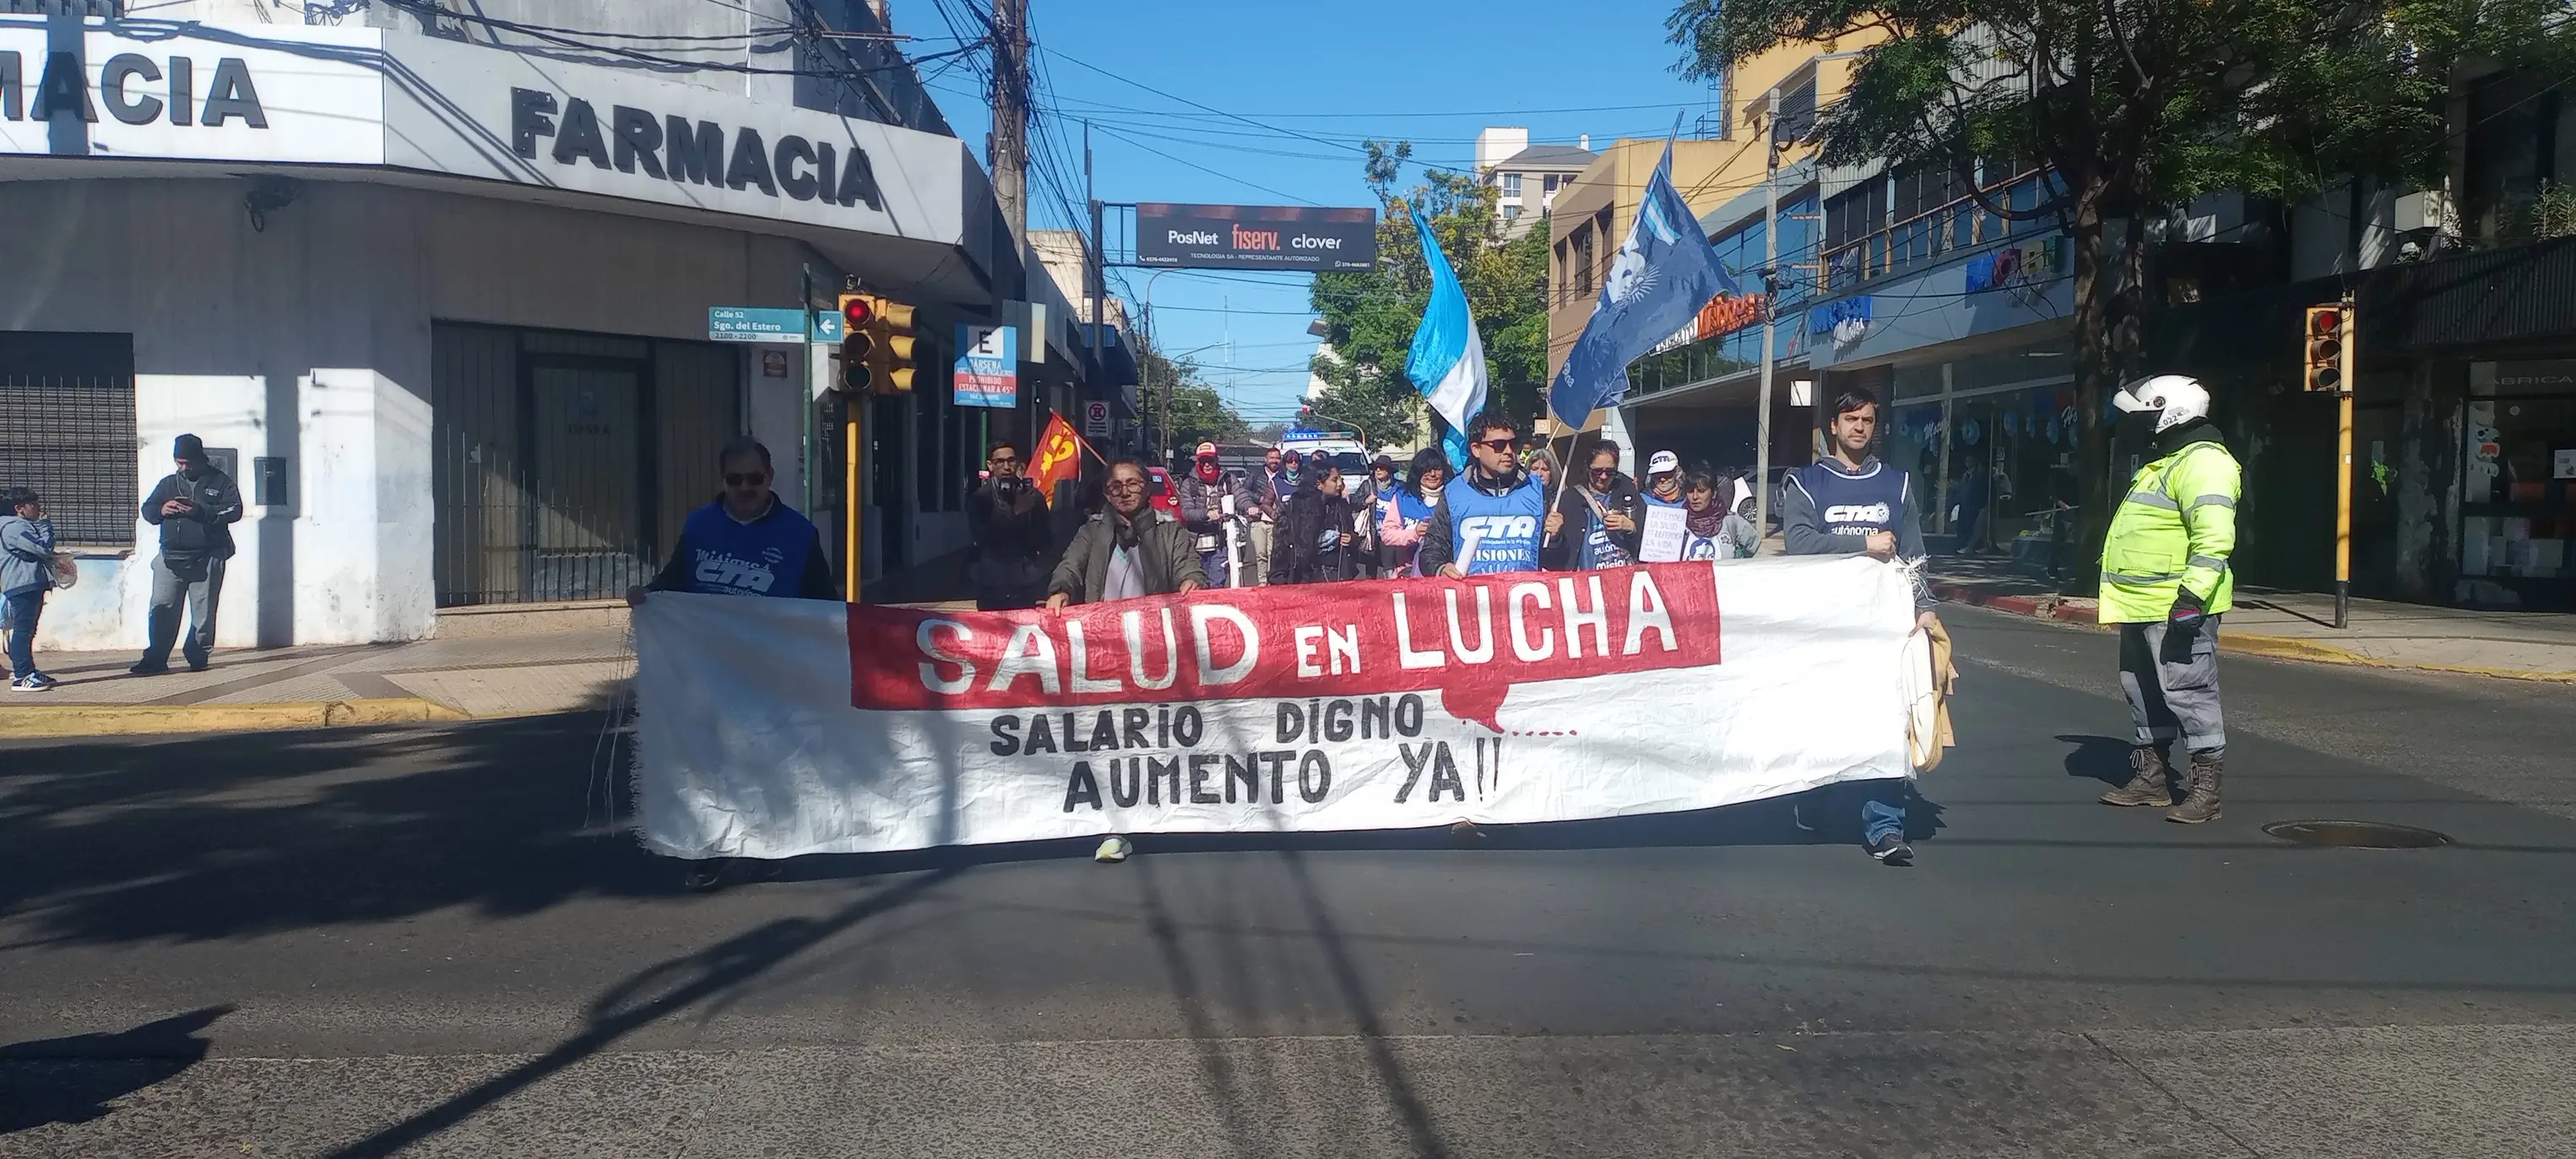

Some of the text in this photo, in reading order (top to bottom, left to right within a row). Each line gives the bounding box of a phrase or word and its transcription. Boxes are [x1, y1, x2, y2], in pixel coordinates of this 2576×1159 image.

[510, 87, 882, 212] FARMACIA
[1169, 230, 1218, 245] PosNet
[1292, 234, 1342, 250] clover
[713, 322, 781, 331] Sgo. del Estero
[979, 330, 992, 354] E
[968, 376, 1001, 384] PROHIBIDO
[2163, 415, 2178, 425] 022
[1825, 505, 1878, 523] CTA
[1460, 516, 1536, 539] CTA
[1472, 549, 1531, 561] ISIONES
[696, 561, 775, 593] CTA
[916, 570, 1678, 695] SALUD EN LUCHA
[990, 693, 1424, 756] SALARIO DIGNO
[1063, 750, 1331, 813] AUMENTO
